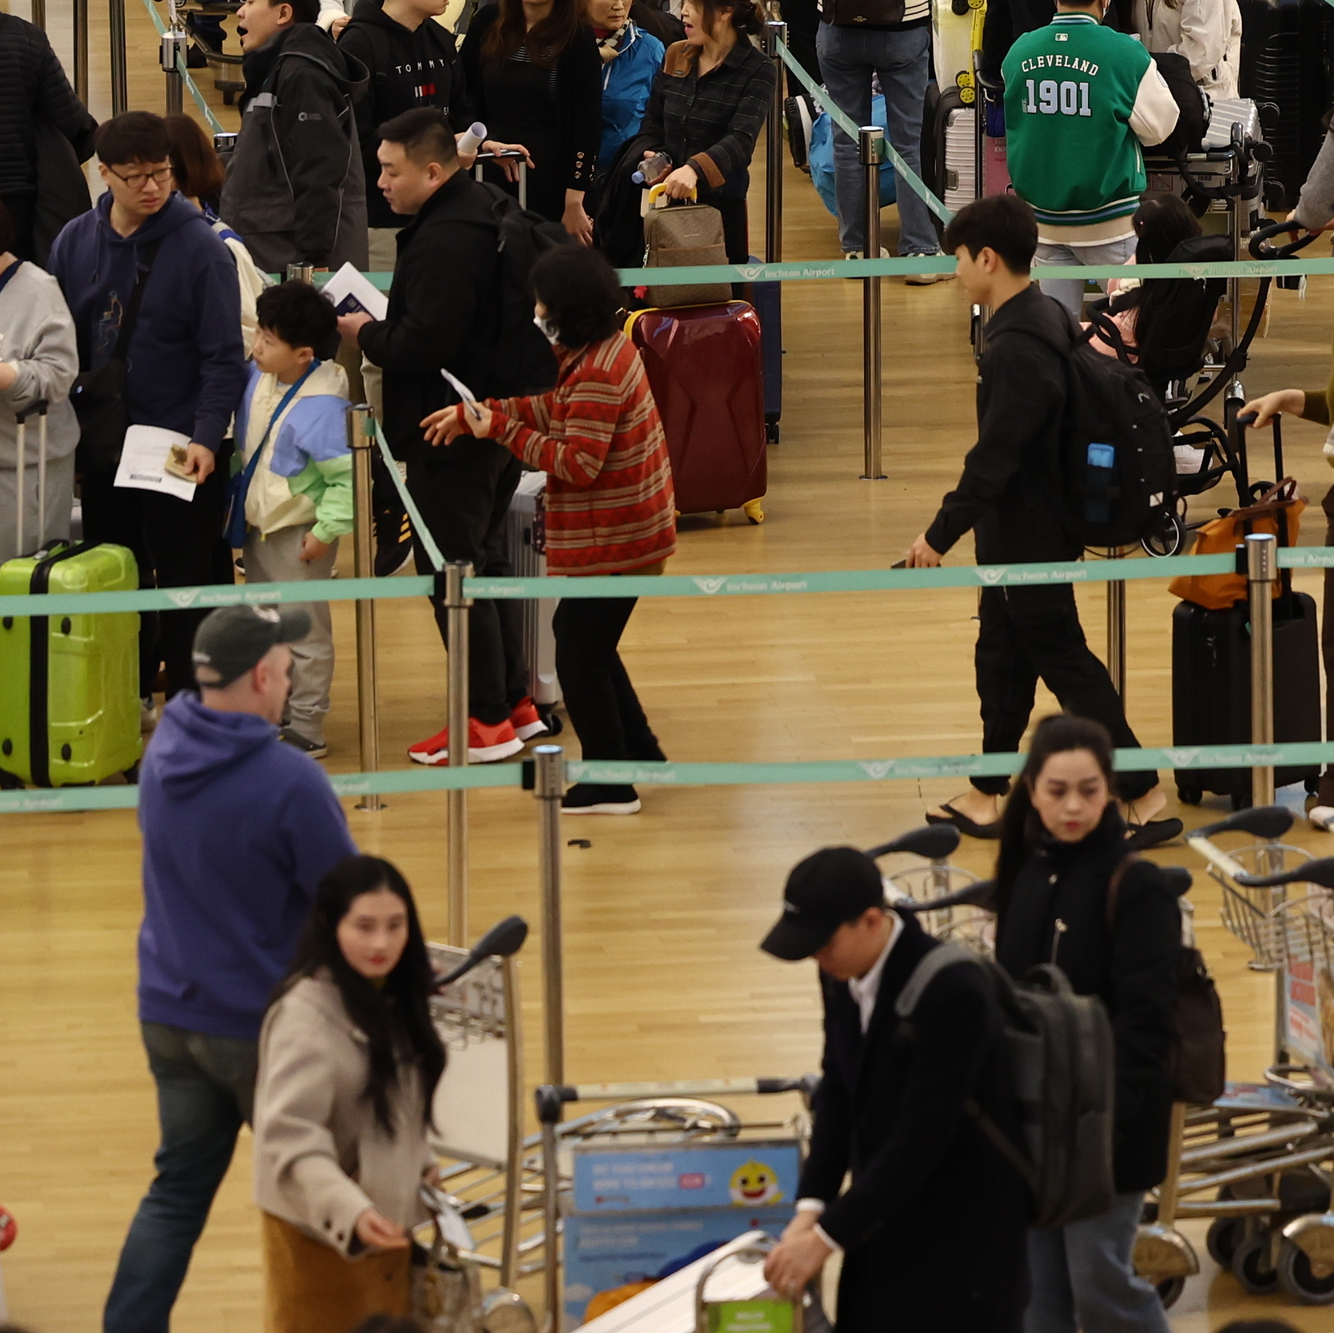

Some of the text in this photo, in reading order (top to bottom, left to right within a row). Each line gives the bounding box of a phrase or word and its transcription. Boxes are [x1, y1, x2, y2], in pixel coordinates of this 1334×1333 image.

[395, 59, 445, 74] TOMMY
[1021, 55, 1099, 77] CLEVELAND
[1025, 79, 1092, 116] 1901
[764, 266, 835, 279] Incheon Airport
[1209, 264, 1279, 276] Incheon Airport
[1007, 568, 1088, 582] Incheon Airport
[487, 582, 525, 596] Airport
[726, 580, 808, 593] Incheon Airport
[200, 589, 281, 604] Incheon Airport
